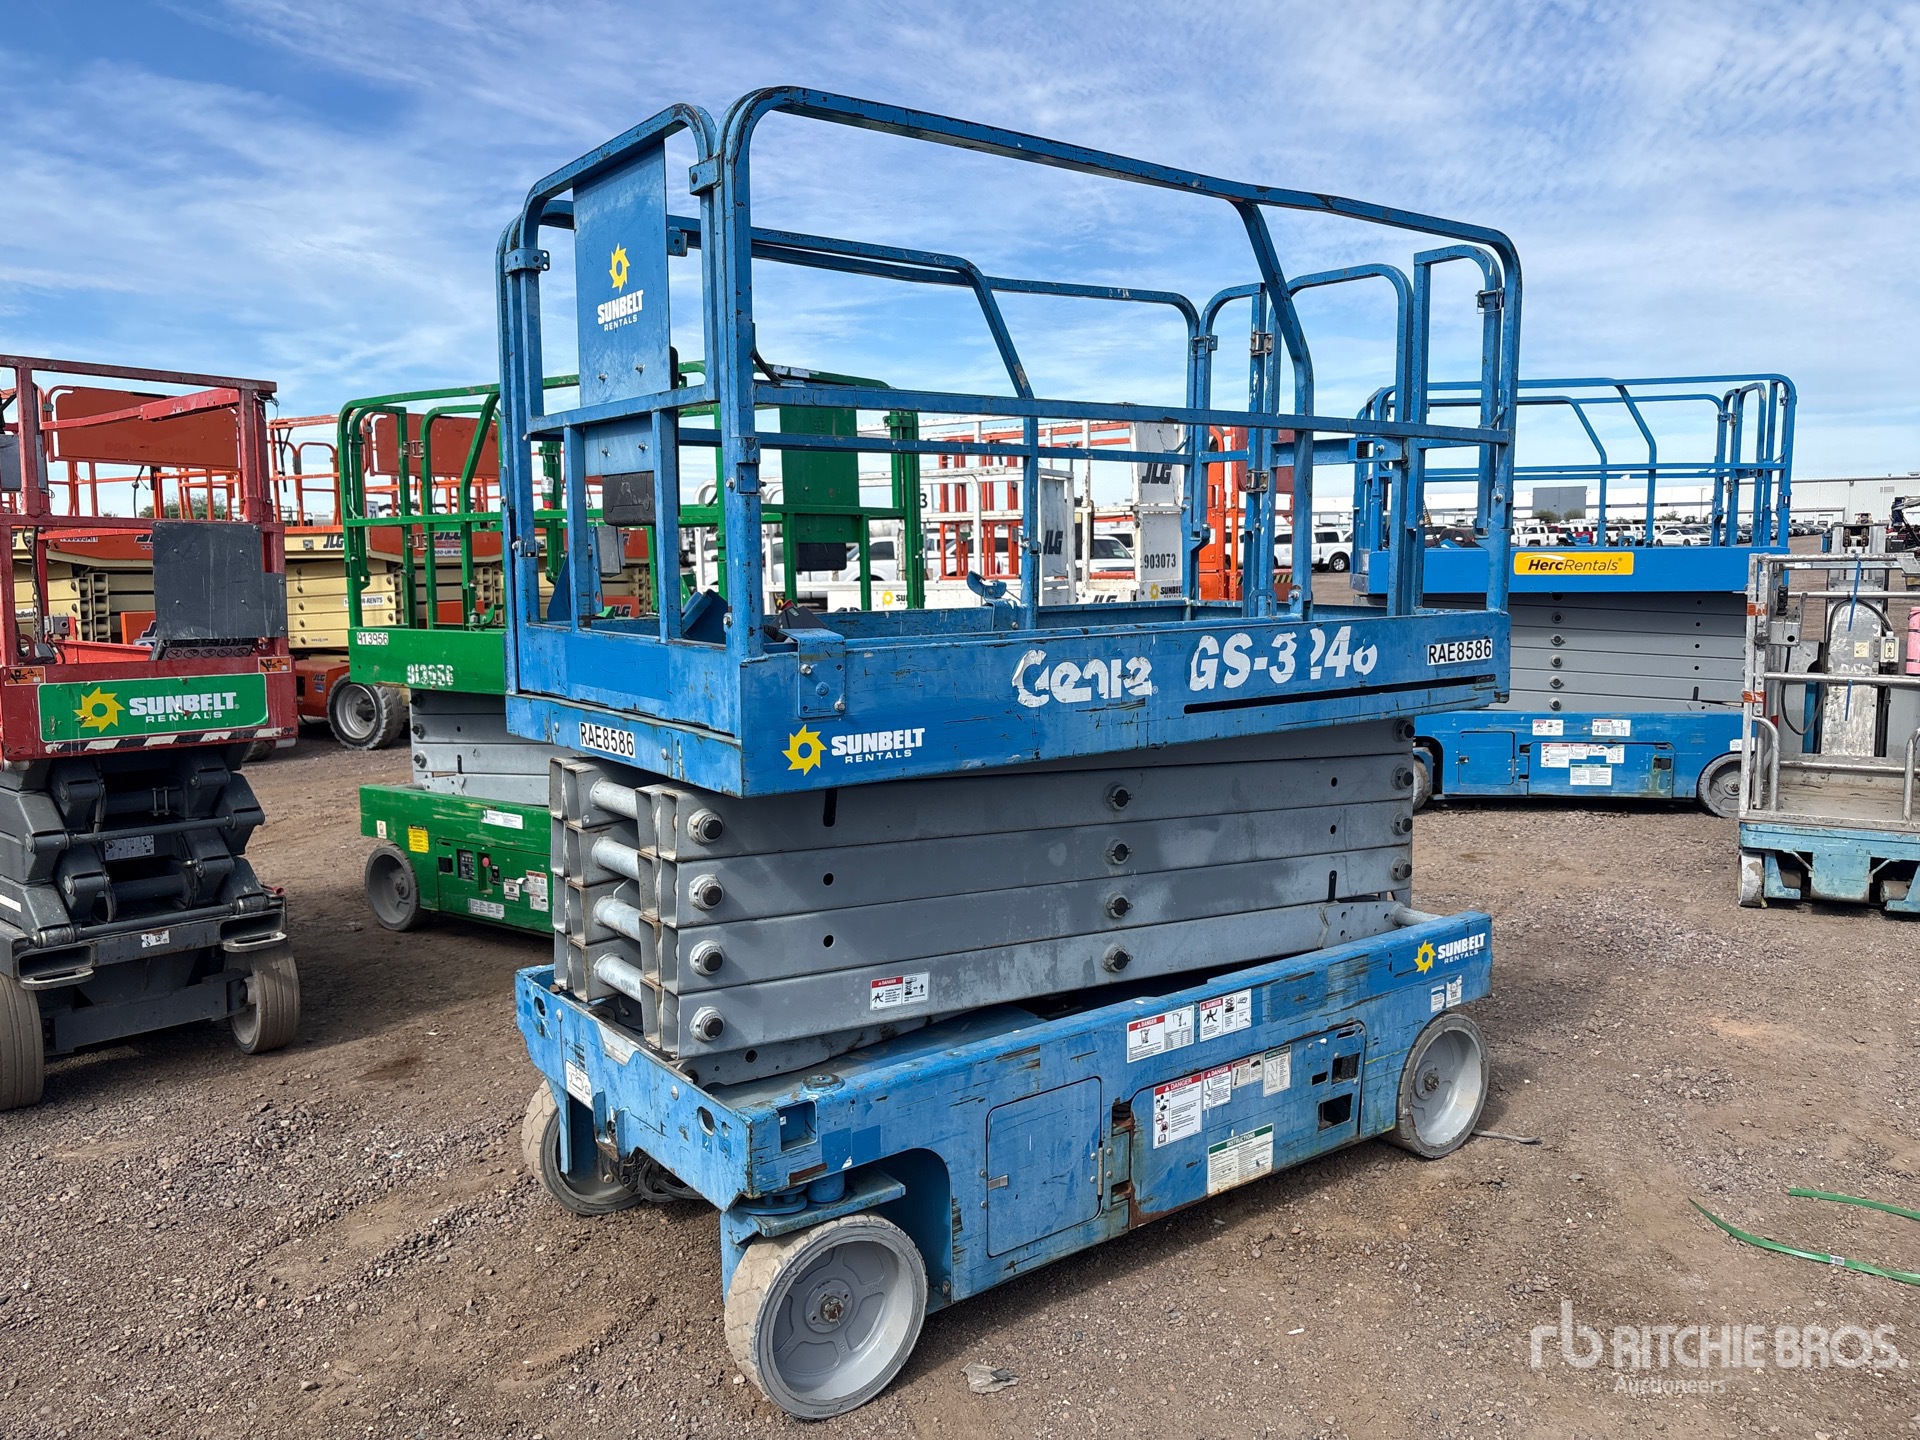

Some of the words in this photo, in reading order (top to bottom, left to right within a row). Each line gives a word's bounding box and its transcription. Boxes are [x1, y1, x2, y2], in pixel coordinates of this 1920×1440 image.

[597, 289, 644, 325] SUNBELT
[603, 314, 638, 332] RENTALS
[1141, 463, 1173, 485] JLG
[323, 535, 344, 549] JLG
[1043, 530, 1064, 555] JLG
[1143, 553, 1177, 569] 903073
[1528, 559, 1618, 571] HercRentals
[1160, 586, 1182, 594] SUNBEL
[614, 605, 632, 618] LG
[357, 632, 388, 645] 913956
[1428, 640, 1492, 664] RAE8586
[129, 691, 237, 716] SUNBELT
[145, 711, 223, 723] RENTALS
[580, 722, 634, 756] RAE8586
[831, 728, 926, 757] SUNBELT
[845, 749, 912, 764] RENTALS
[1437, 932, 1486, 960] SUNBELT
[1443, 948, 1479, 964] RENTALS
[1140, 1017, 1158, 1027] DANGER
[1211, 1066, 1229, 1077] DANGER
[1170, 1078, 1193, 1090] DANGER
[1226, 1131, 1256, 1147] INSTRUCTIONS
